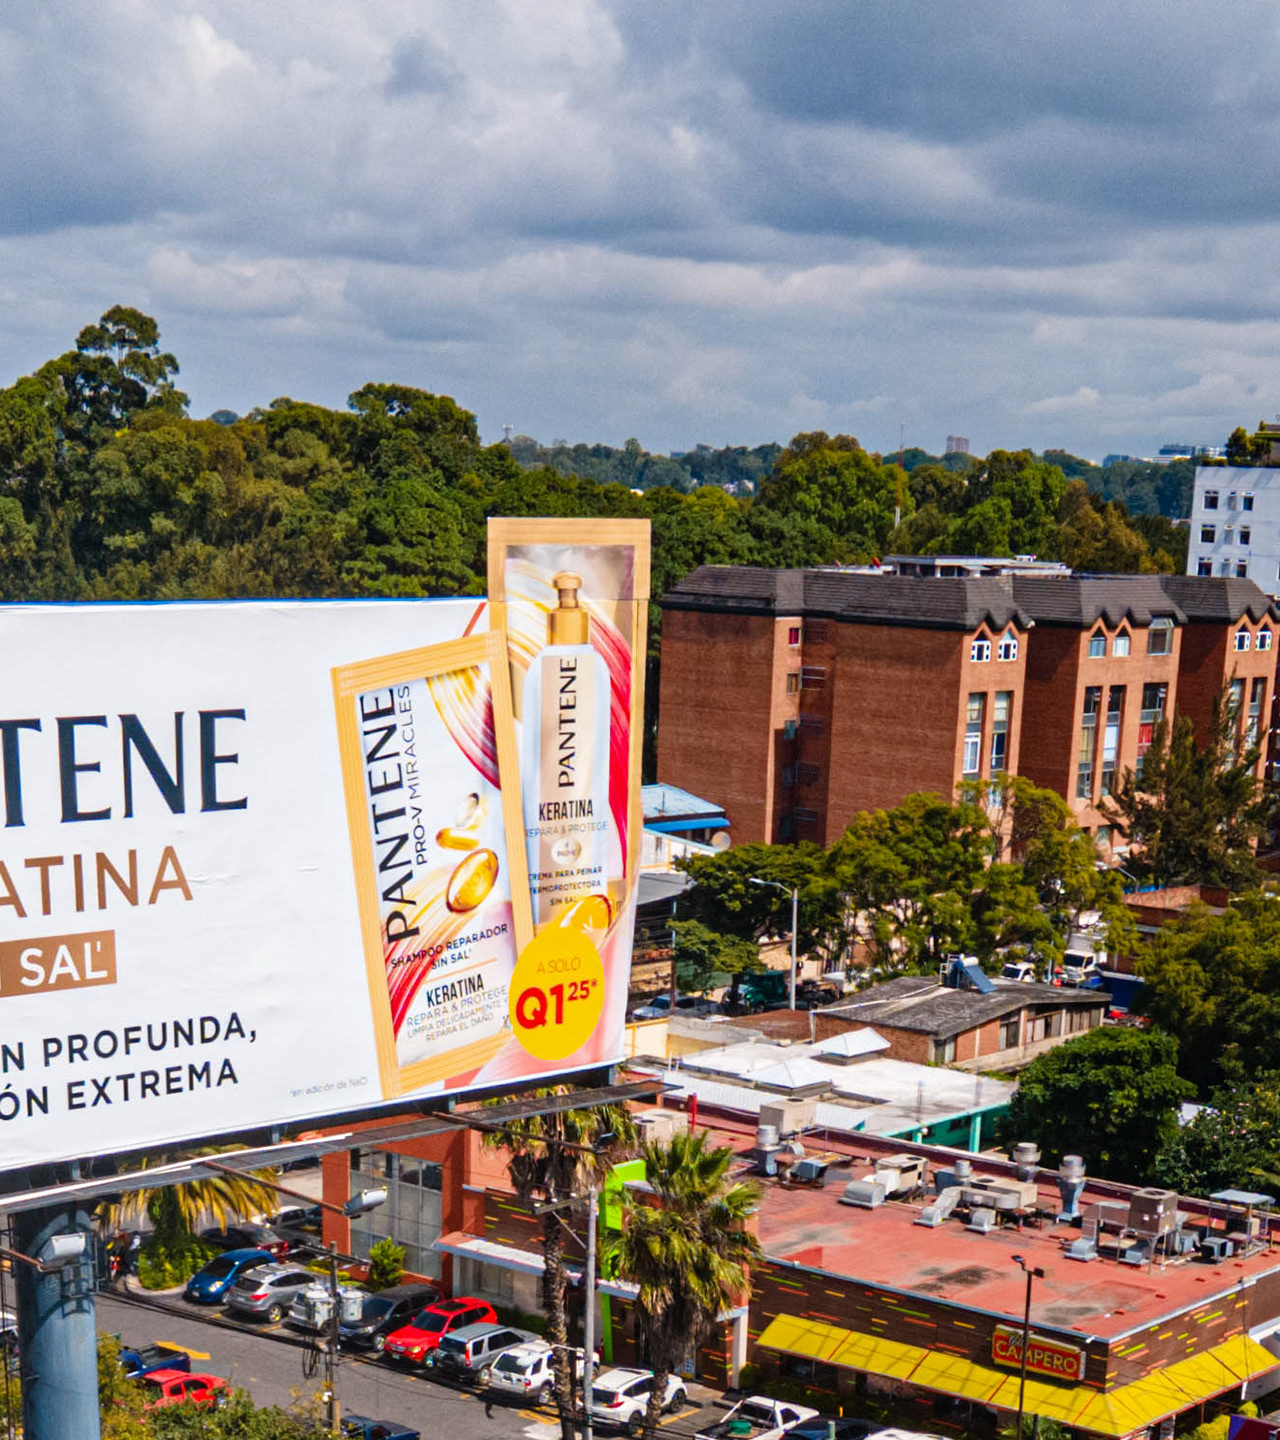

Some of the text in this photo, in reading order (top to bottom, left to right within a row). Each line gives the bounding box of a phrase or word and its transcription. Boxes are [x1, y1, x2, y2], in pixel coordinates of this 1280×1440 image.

[558, 657, 578, 788] PANTENE
[397, 685, 428, 866] PRO-V MIRACLES
[360, 687, 421, 944] PANTENE
[538, 799, 594, 822] KERATINA
[390, 923, 508, 970] SHAMPOO REPARADOR
[431, 957, 448, 970] SIN
[537, 956, 581, 974] A SOLO
[406, 1005, 449, 1027] REPARA
[461, 984, 508, 1011] PROTEGE
[426, 974, 484, 1008] KERATINA
[43, 1012, 257, 1067] PROFUNDA,
[68, 1058, 239, 1110] EXTREMA
[995, 1340, 1078, 1373] CAMPERO
